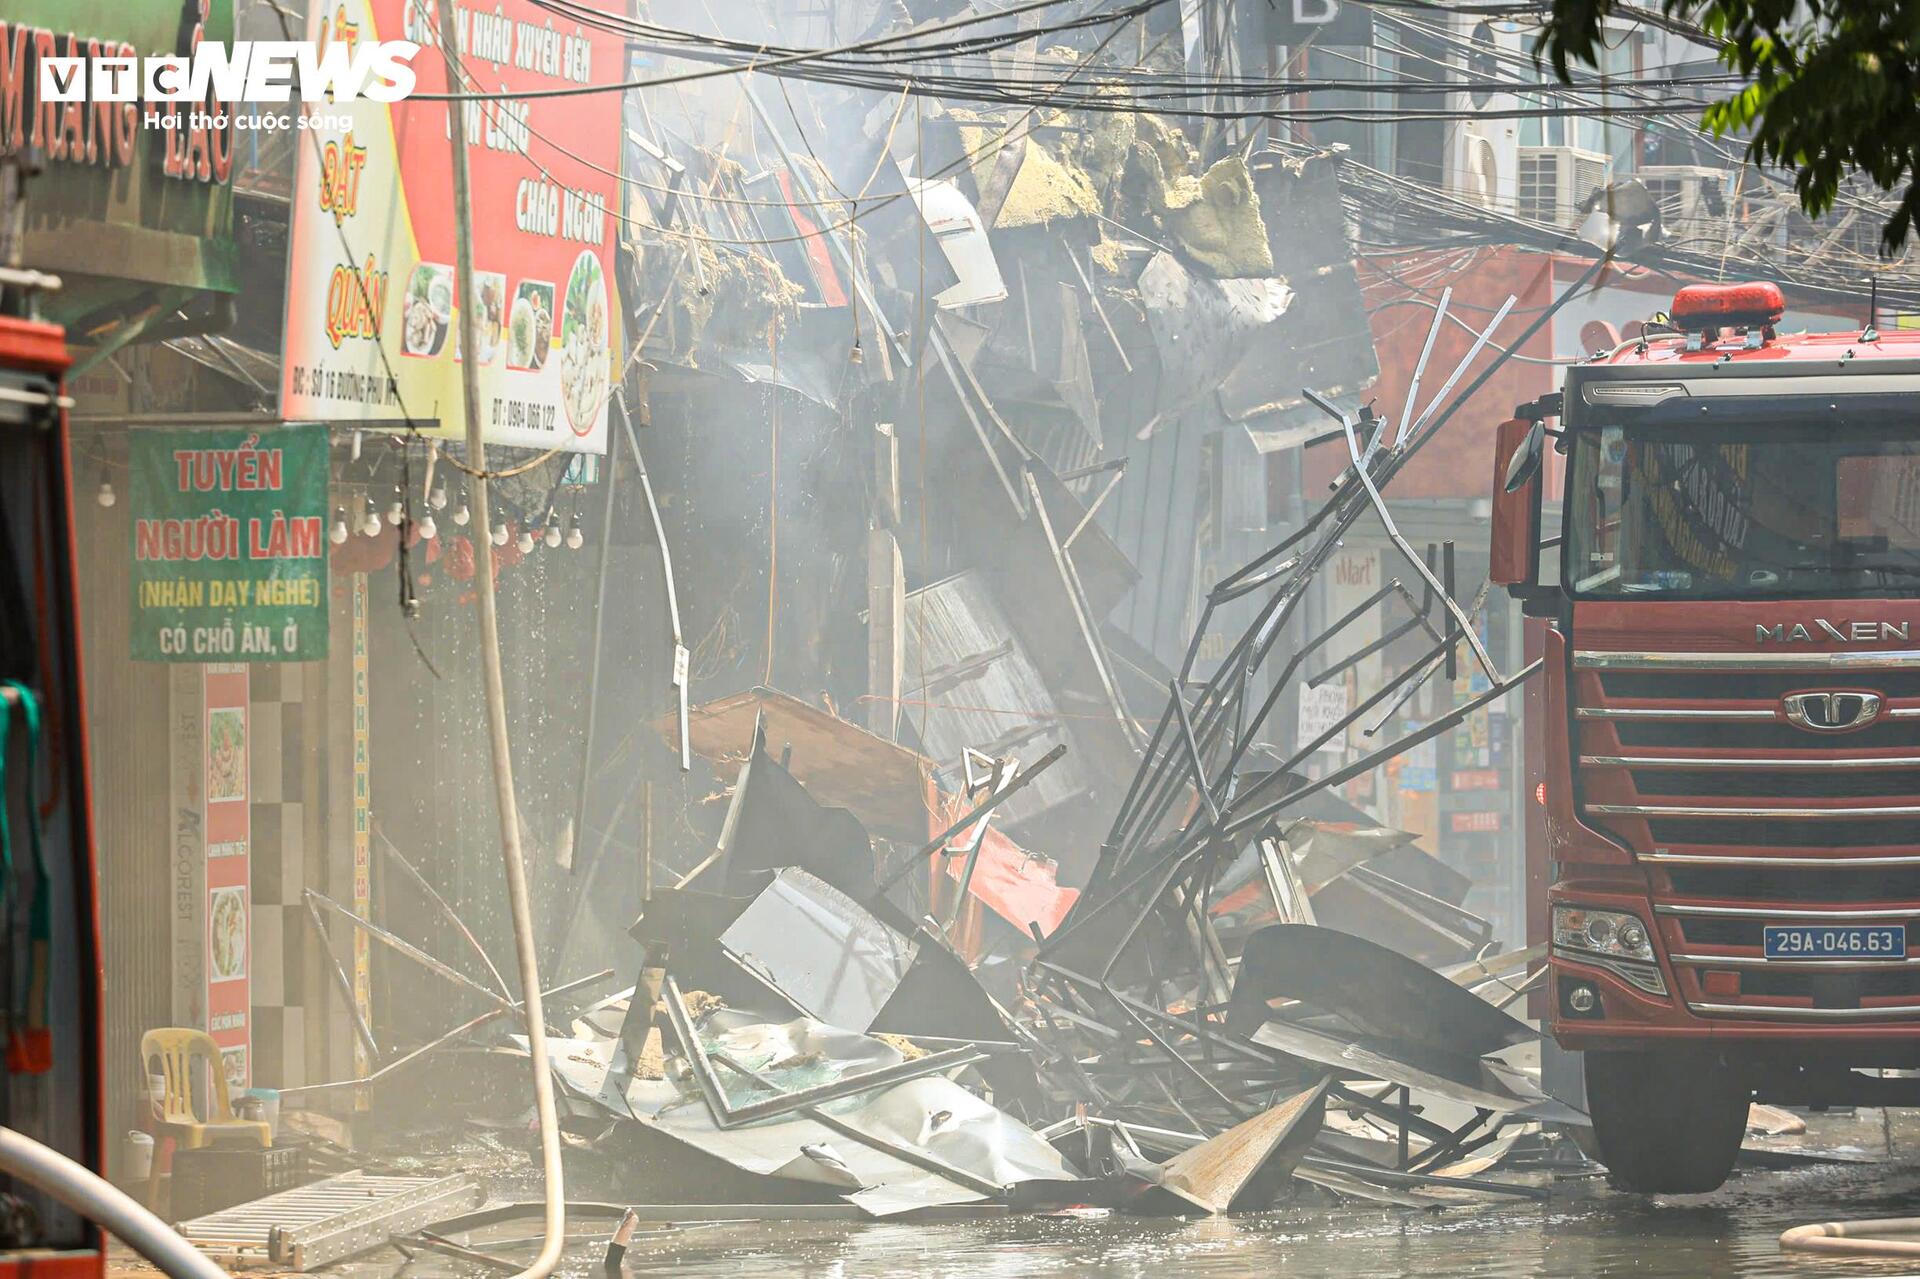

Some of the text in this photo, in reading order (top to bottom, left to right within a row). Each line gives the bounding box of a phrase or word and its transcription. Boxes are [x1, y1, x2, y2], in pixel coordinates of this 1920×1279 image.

[515, 17, 561, 77] XUYÊN
[515, 168, 559, 237] CHÁO
[326, 252, 389, 350] QUÁN
[174, 433, 283, 492] TUYỂN
[135, 508, 323, 561] NGƯỜI LÀM
[140, 570, 320, 613] (NHẬN DẠY NGHỀ)
[159, 622, 187, 654] CÓ
[193, 617, 235, 654] CHỖ
[283, 616, 298, 653] Ở
[1755, 618, 1909, 642] MAXEN
[1777, 931, 1893, 952] 29A-046.63
